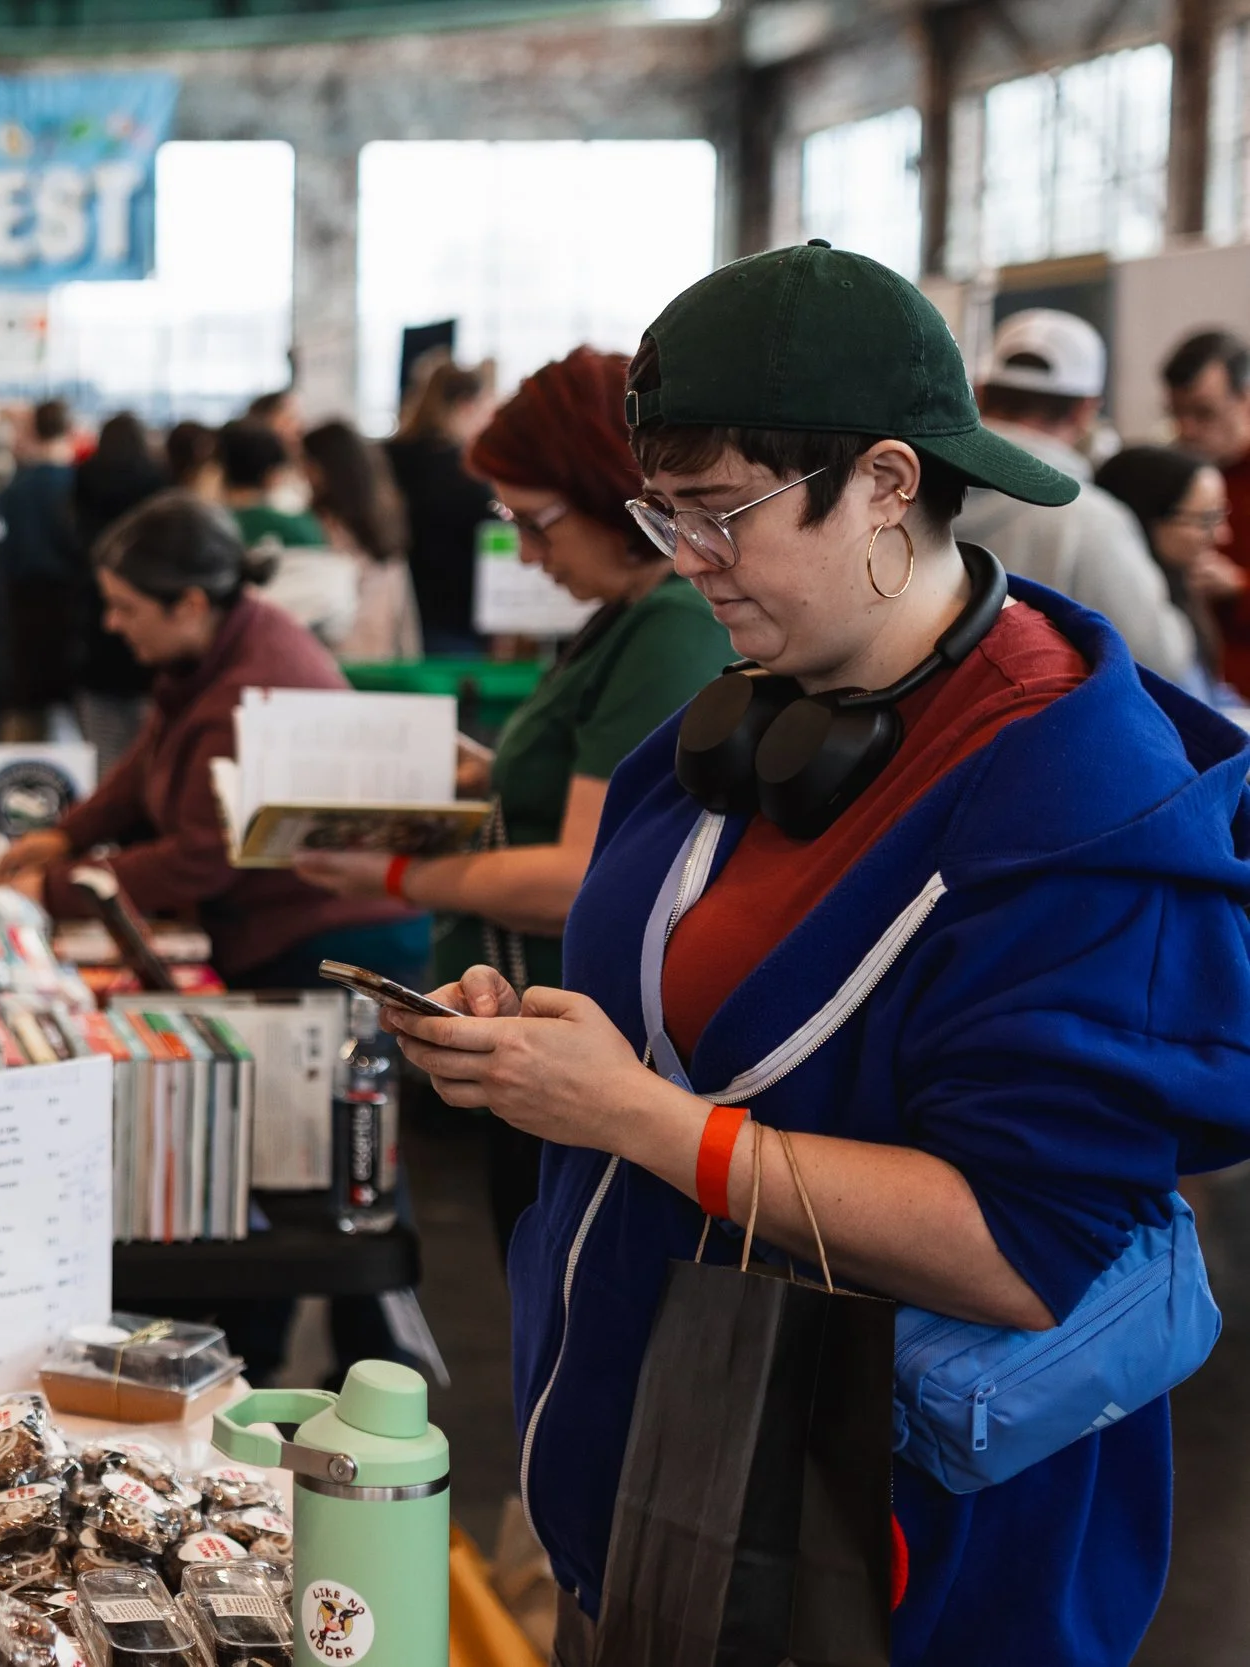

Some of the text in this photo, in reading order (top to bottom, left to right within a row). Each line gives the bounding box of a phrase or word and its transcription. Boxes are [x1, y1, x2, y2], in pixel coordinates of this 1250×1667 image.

[313, 1587, 365, 1615] LIKE NO
[309, 1629, 355, 1659] UDDER
